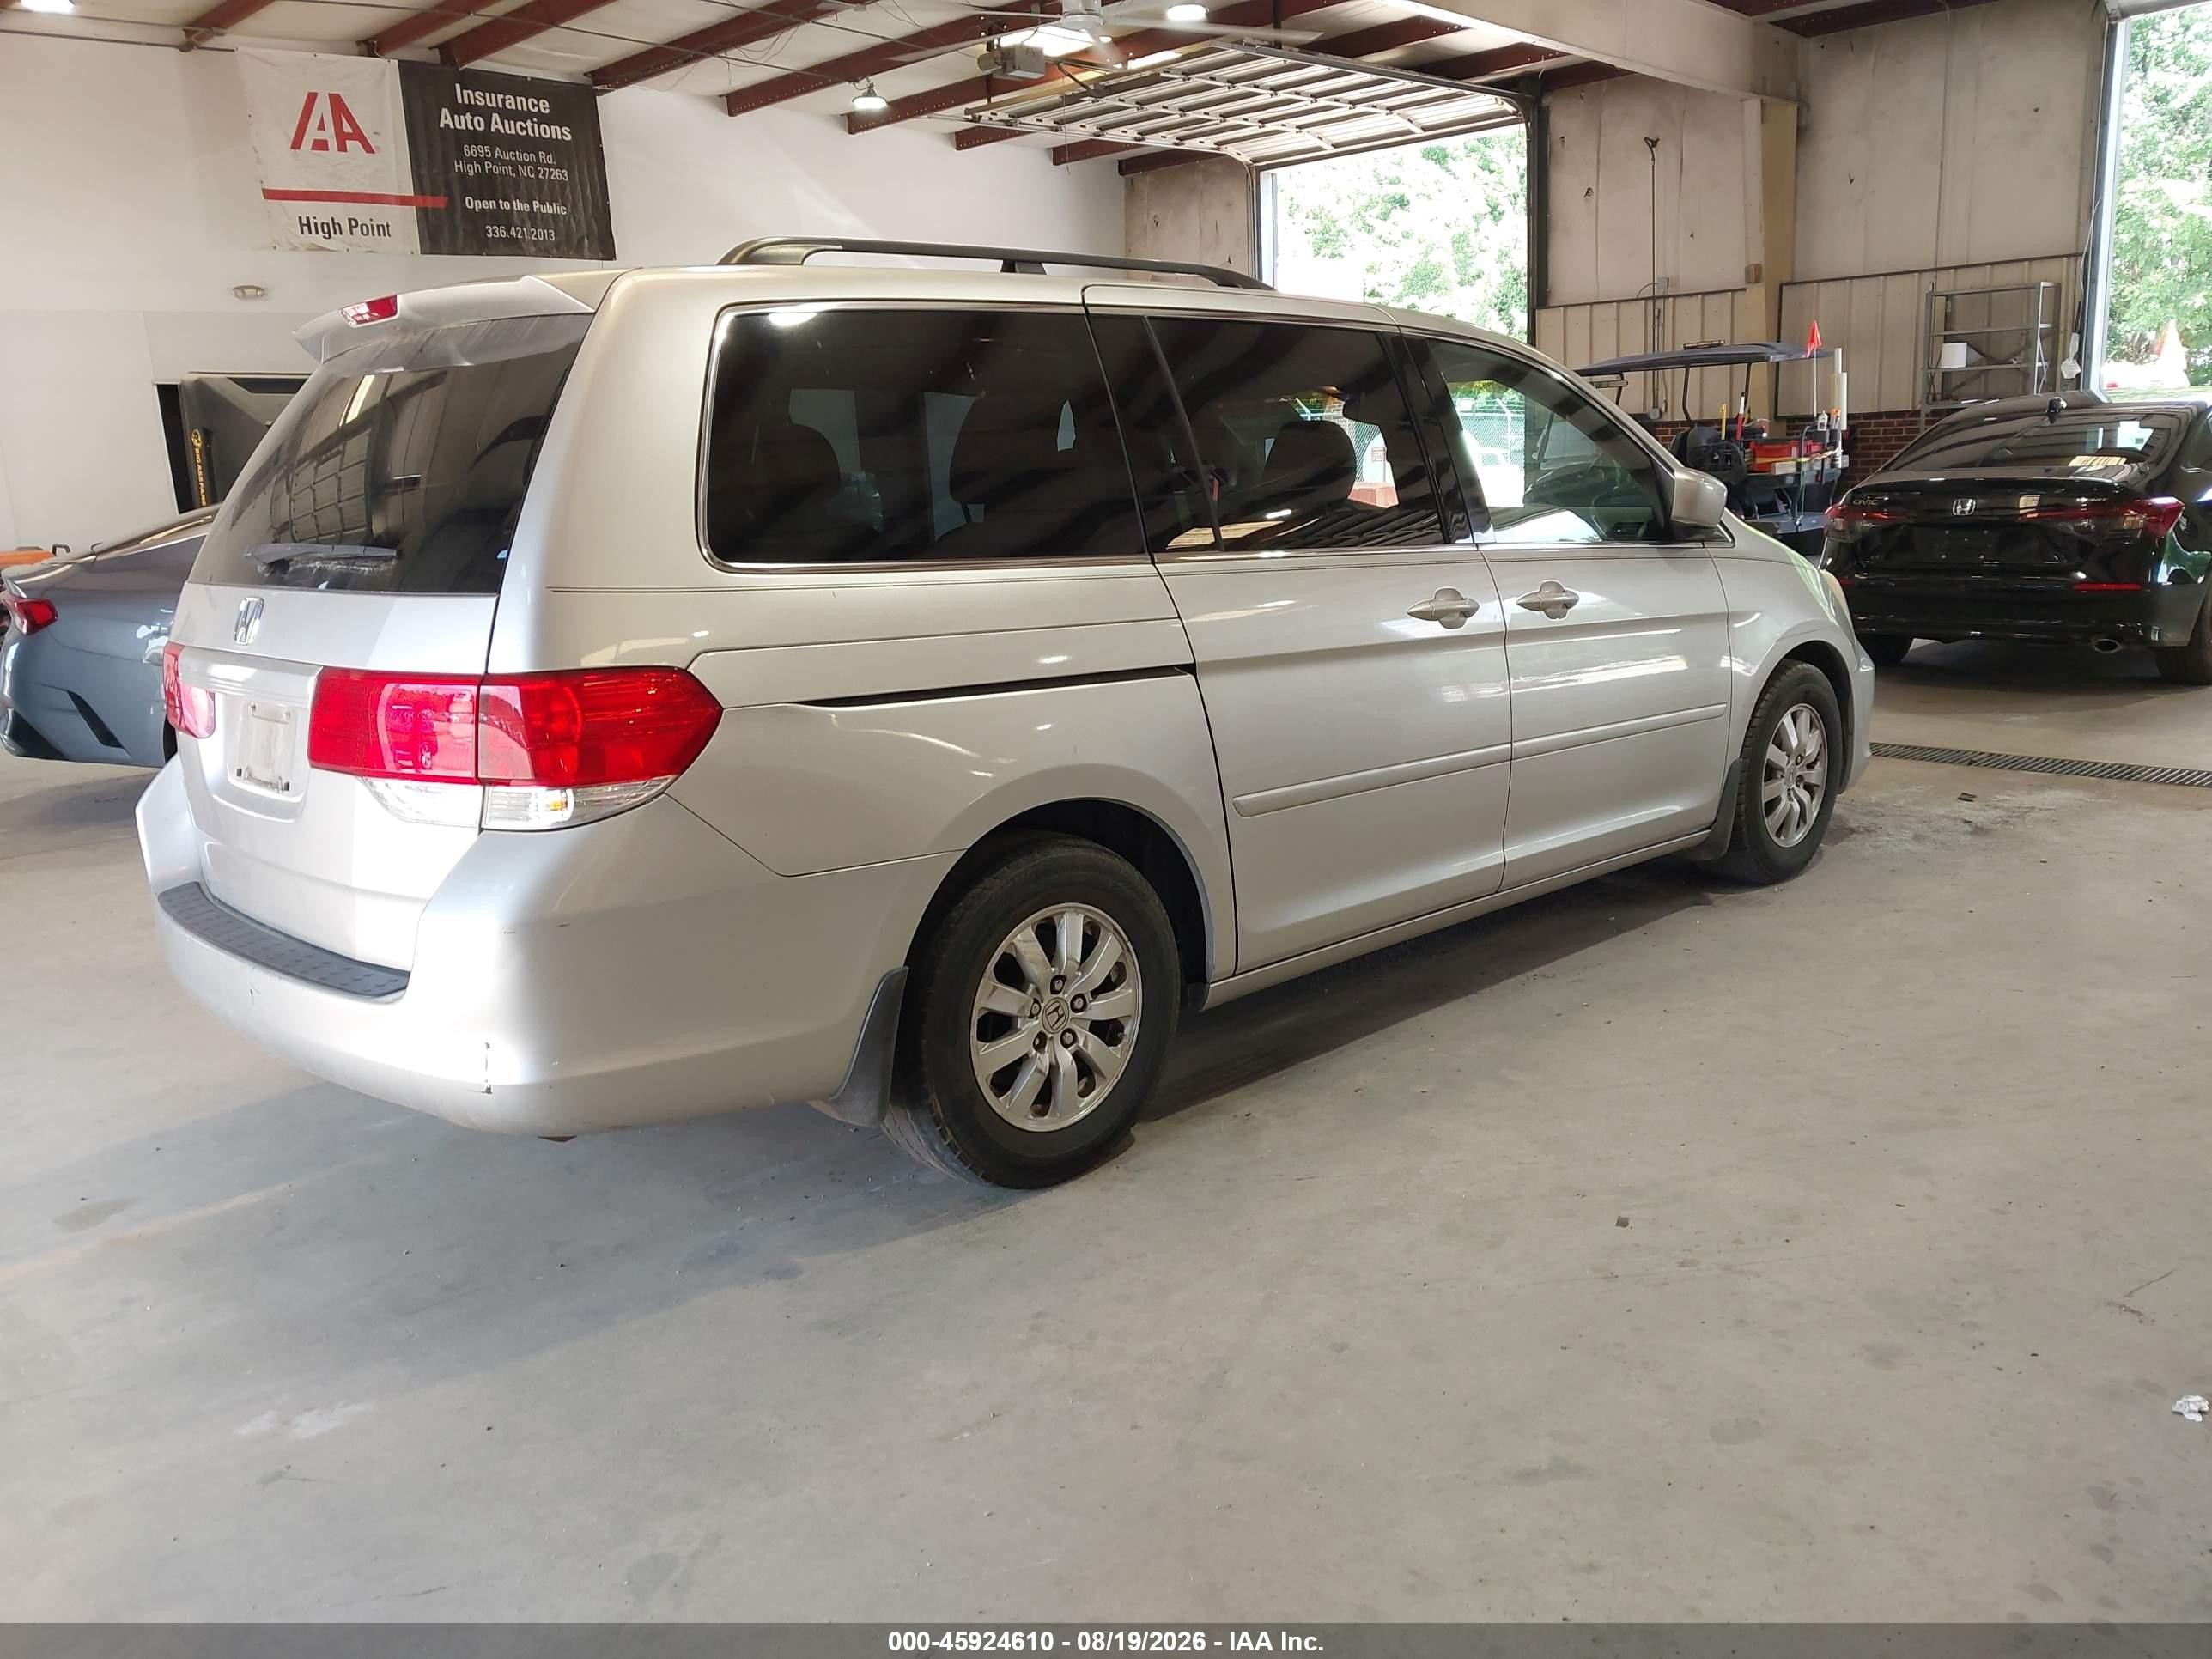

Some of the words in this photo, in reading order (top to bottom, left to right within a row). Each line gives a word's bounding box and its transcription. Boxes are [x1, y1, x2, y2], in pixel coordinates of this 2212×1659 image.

[455, 83, 550, 114] Insurance
[439, 107, 485, 131] Auto
[490, 112, 573, 141] Auctions
[463, 144, 492, 158] 6695
[495, 147, 536, 163] Auction
[538, 151, 556, 166] Rd.
[454, 160, 482, 177] High
[484, 161, 516, 178] Point,
[518, 165, 535, 179] NC
[538, 167, 569, 182] 27263
[465, 196, 496, 212] Open
[499, 198, 511, 210] to
[514, 199, 531, 212] the
[532, 200, 568, 216] Public
[298, 216, 343, 240] High
[347, 217, 392, 238] Point
[485, 225, 556, 241] 336.421.2013
